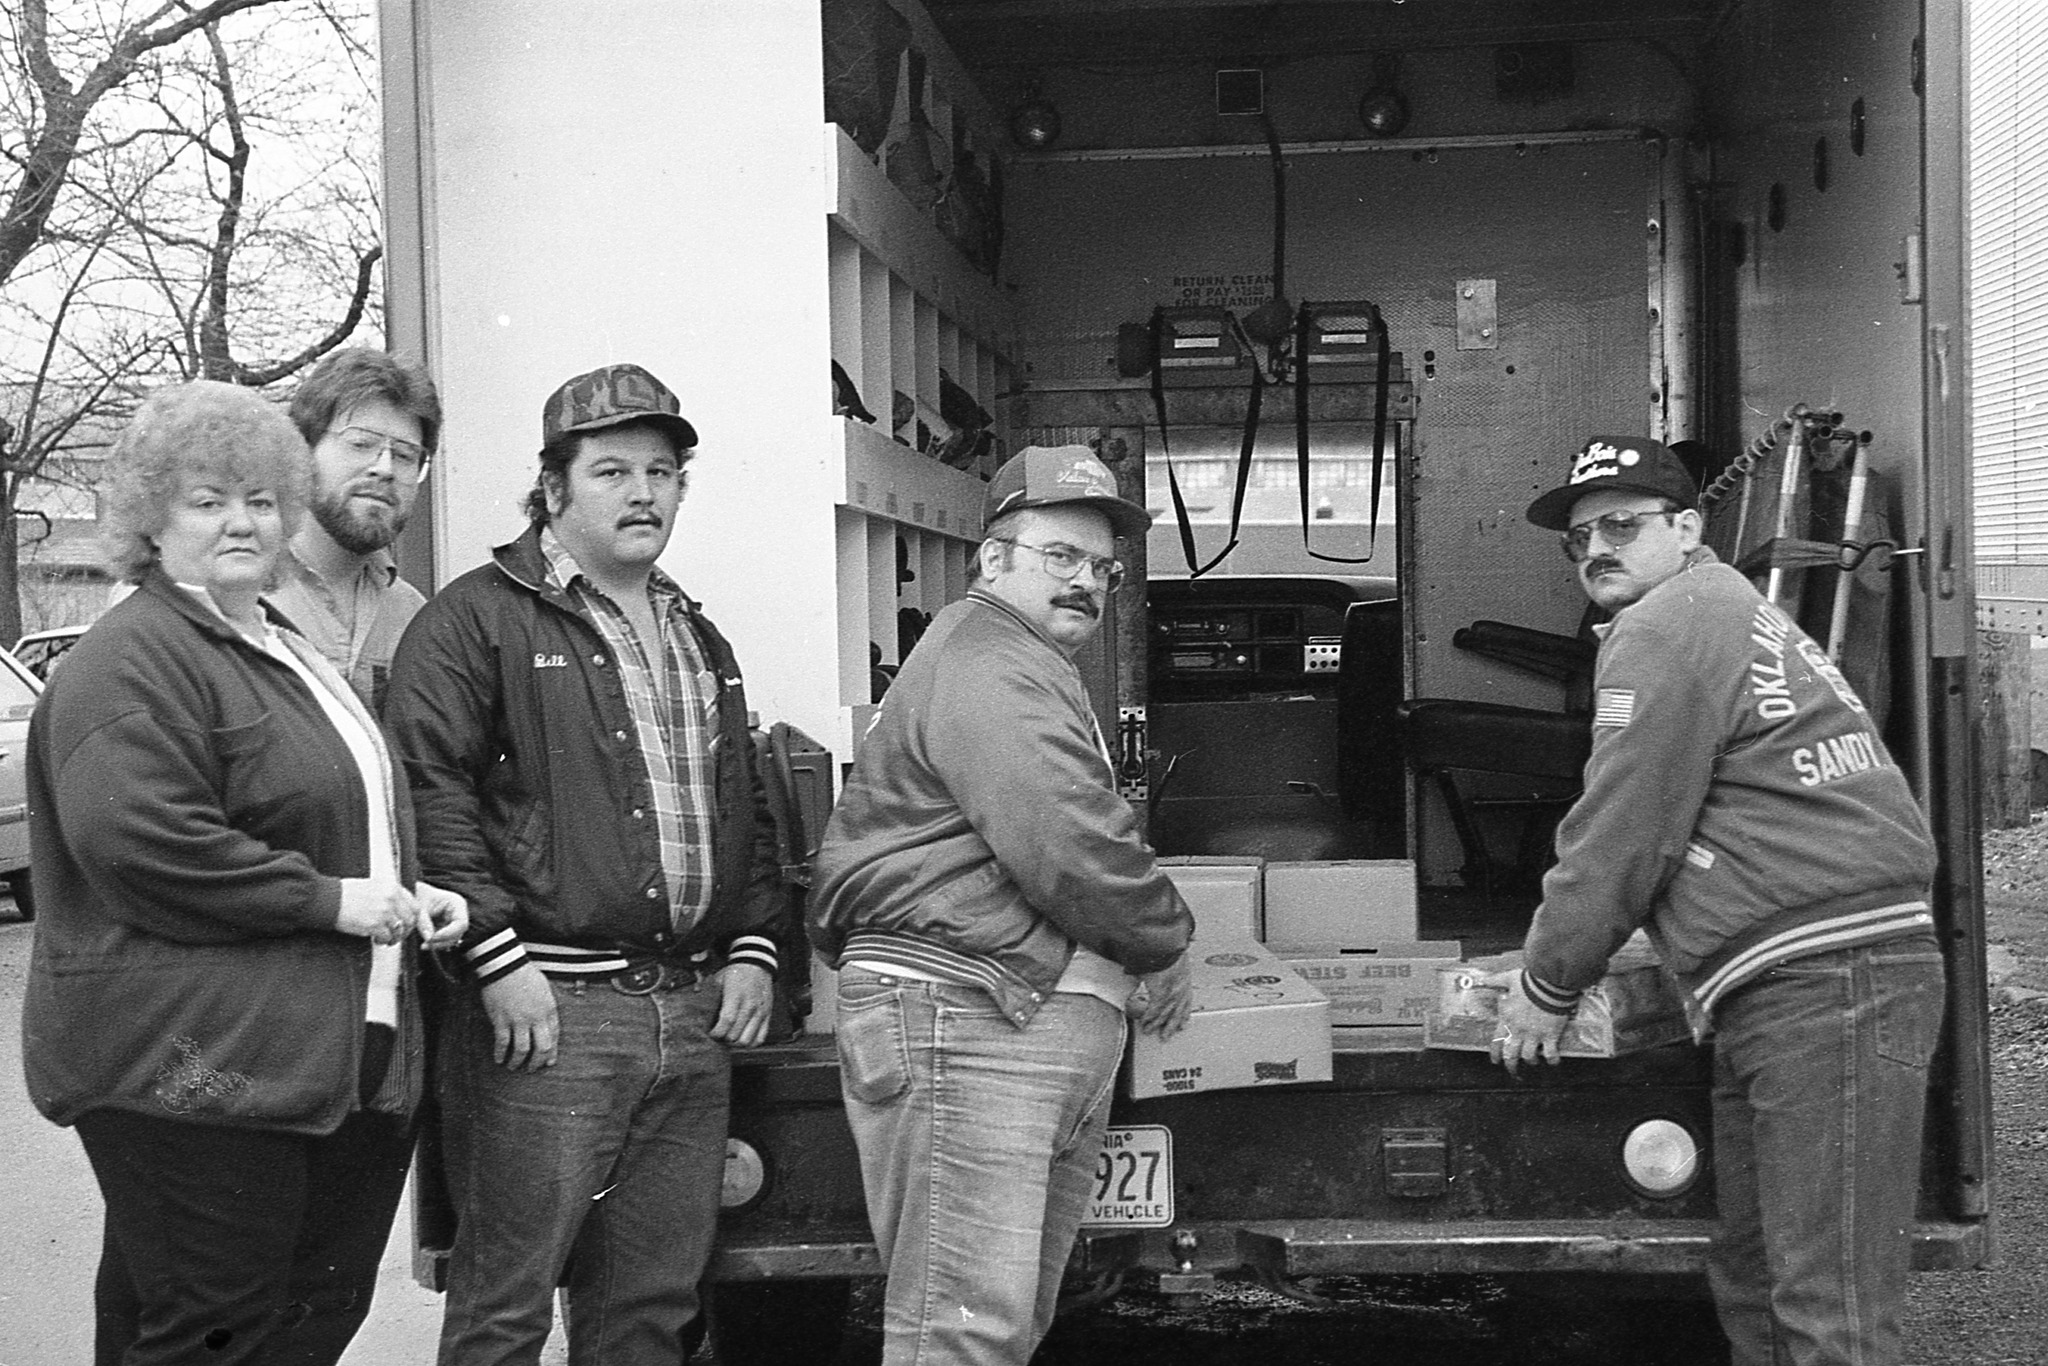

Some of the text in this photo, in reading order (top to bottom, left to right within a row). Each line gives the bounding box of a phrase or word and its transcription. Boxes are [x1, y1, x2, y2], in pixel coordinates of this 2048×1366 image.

[1173, 274, 1274, 287] RETURN CLEAN
[1182, 287, 1201, 298] OR
[1206, 286, 1231, 297] PAY
[533, 652, 568, 668] Bill
[1792, 732, 1881, 787] SANDY
[1360, 964, 1411, 979] BEEF
[1095, 1151, 1161, 1201] 927
[1092, 1204, 1164, 1219] VEHICLE
